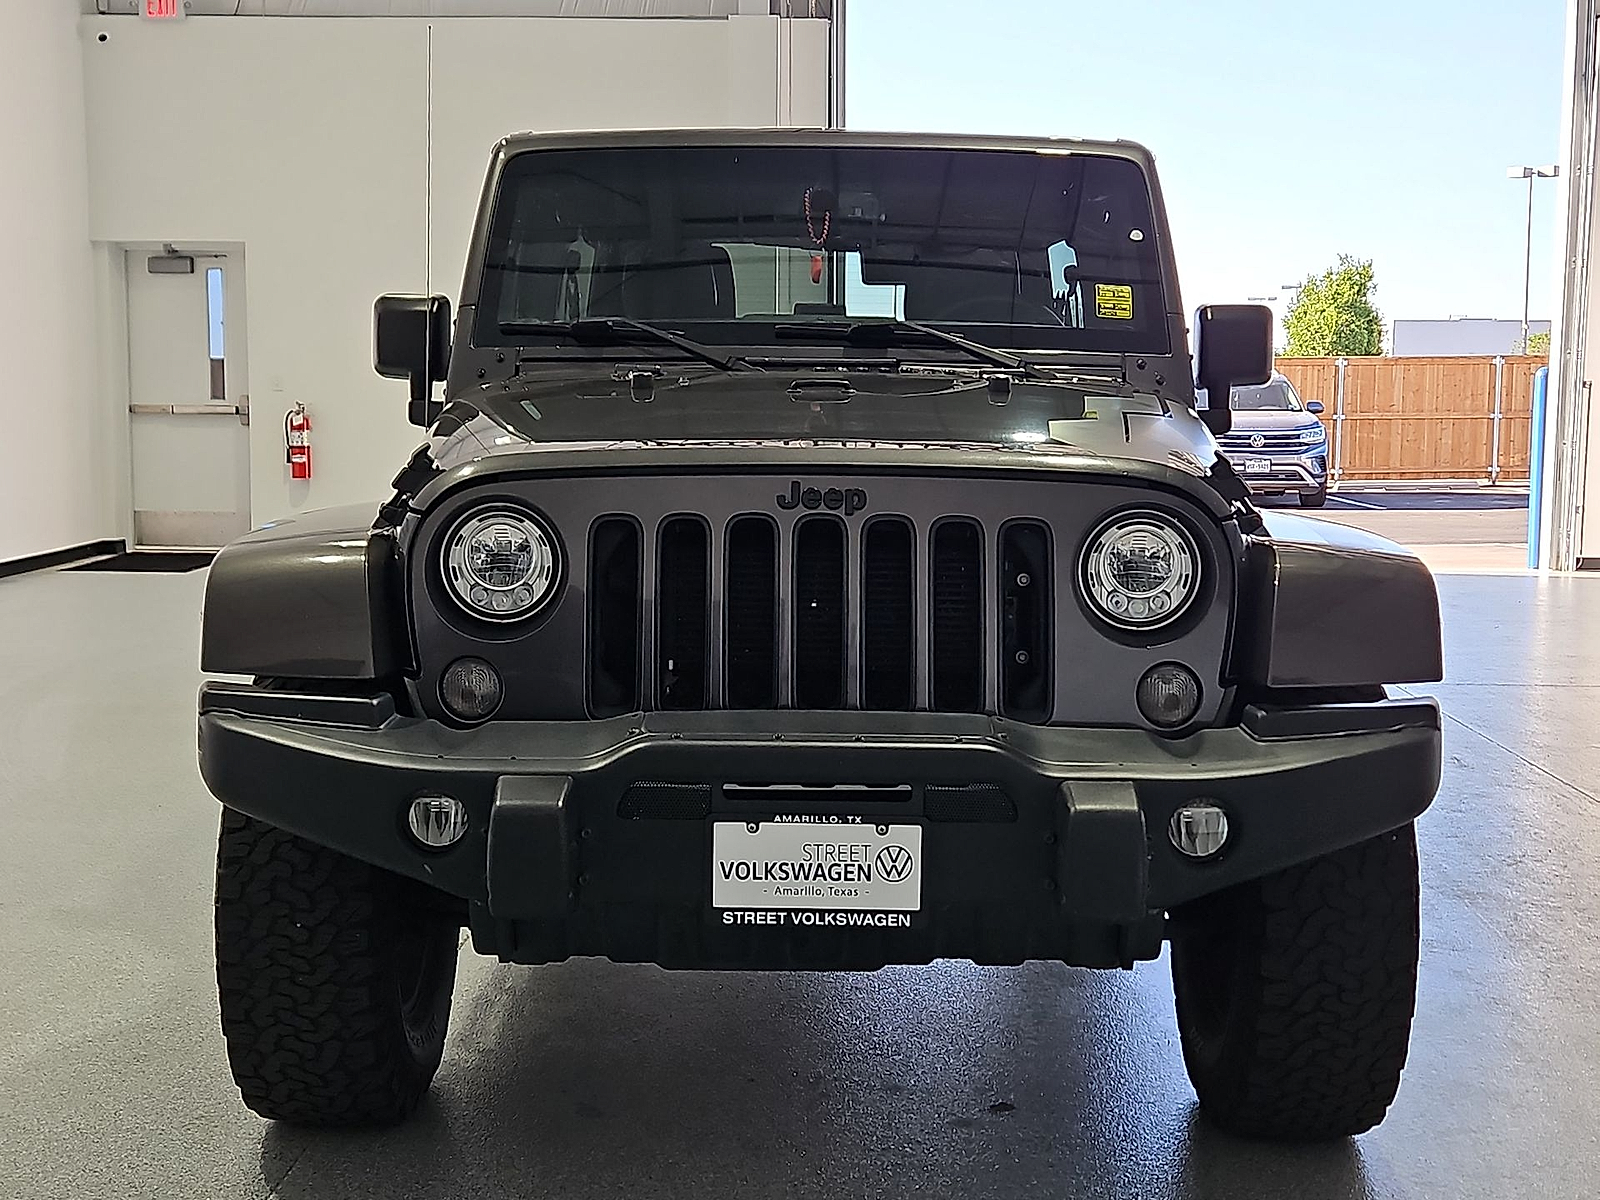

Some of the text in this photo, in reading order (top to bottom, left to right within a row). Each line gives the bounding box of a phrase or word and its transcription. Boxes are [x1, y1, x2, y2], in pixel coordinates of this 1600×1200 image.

[776, 480, 868, 517] Jeep
[774, 815, 862, 824] AMARILLO, TX
[802, 843, 872, 862] STREET
[719, 861, 872, 882] VOLKSWAGEN
[828, 886, 859, 897] Texas
[722, 911, 911, 927] STREET VOLKSWAGEN
